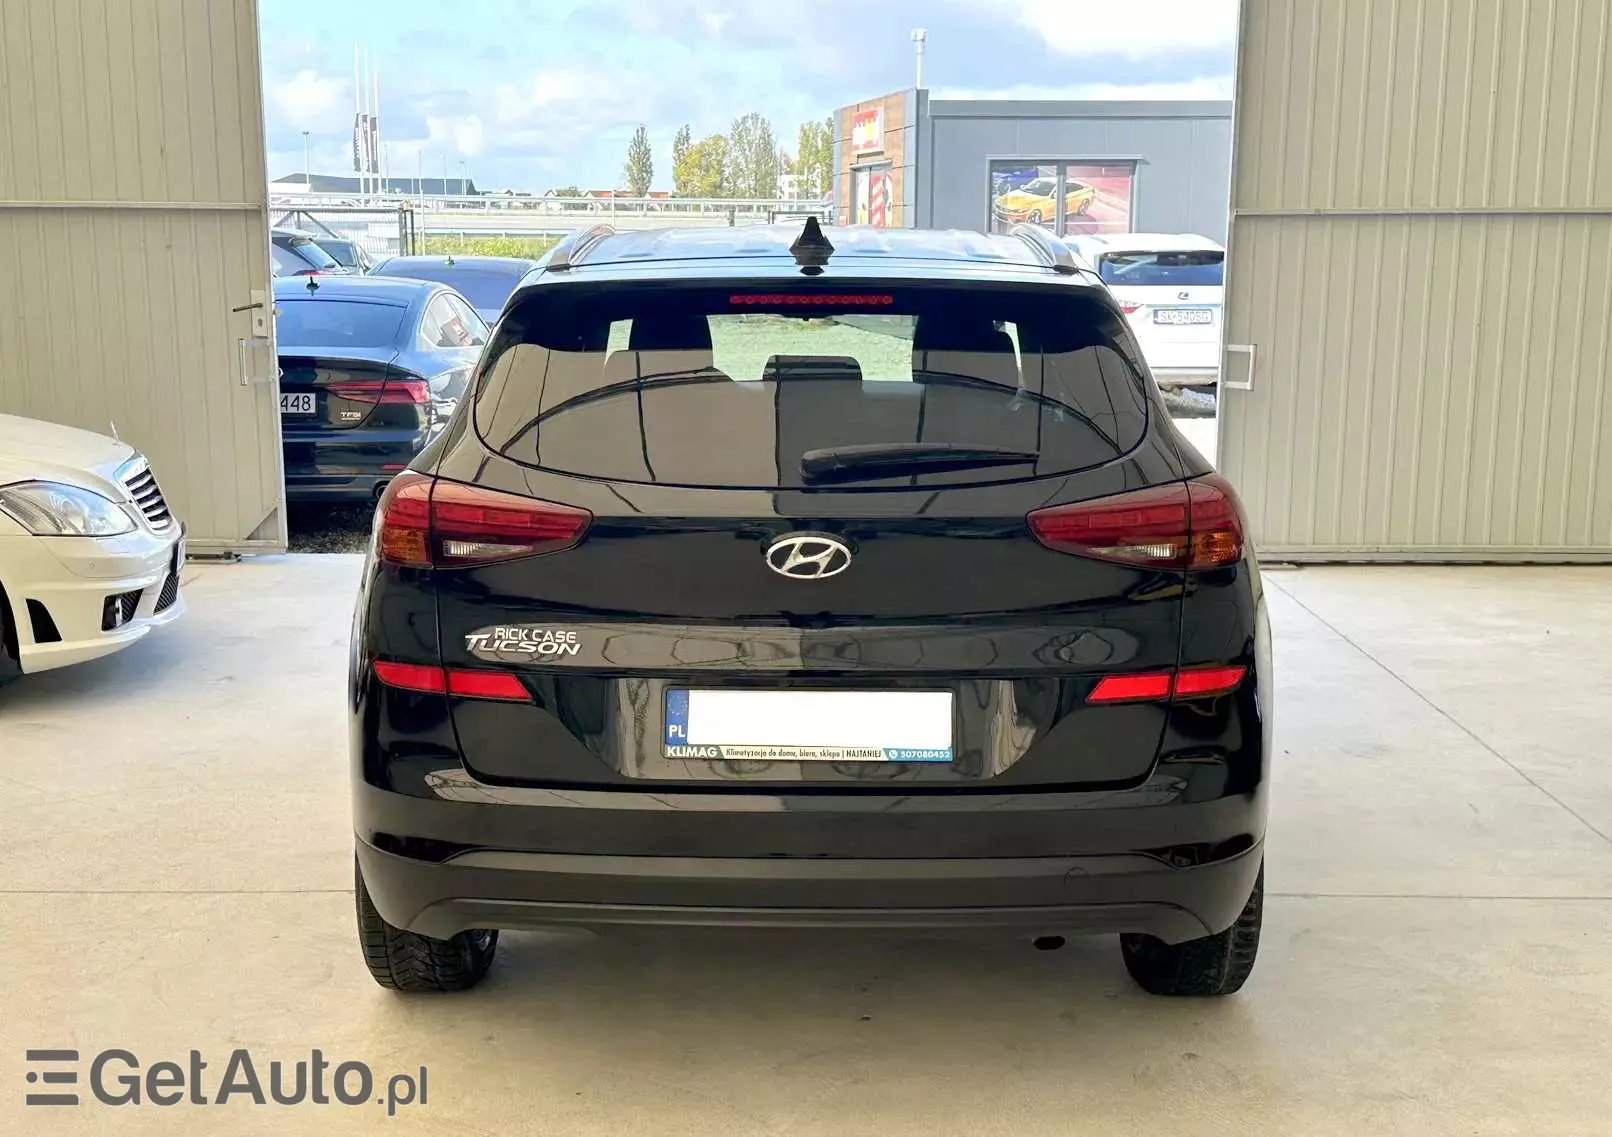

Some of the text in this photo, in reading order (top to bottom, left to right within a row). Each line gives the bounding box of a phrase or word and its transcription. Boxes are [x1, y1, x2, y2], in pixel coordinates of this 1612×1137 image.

[495, 627, 577, 643] RICK CASE
[465, 634, 581, 655] TUCSON
[669, 724, 686, 738] PL
[667, 746, 718, 758] KLIMAG
[769, 748, 777, 757] do
[846, 748, 881, 758] NAJTANIEJ
